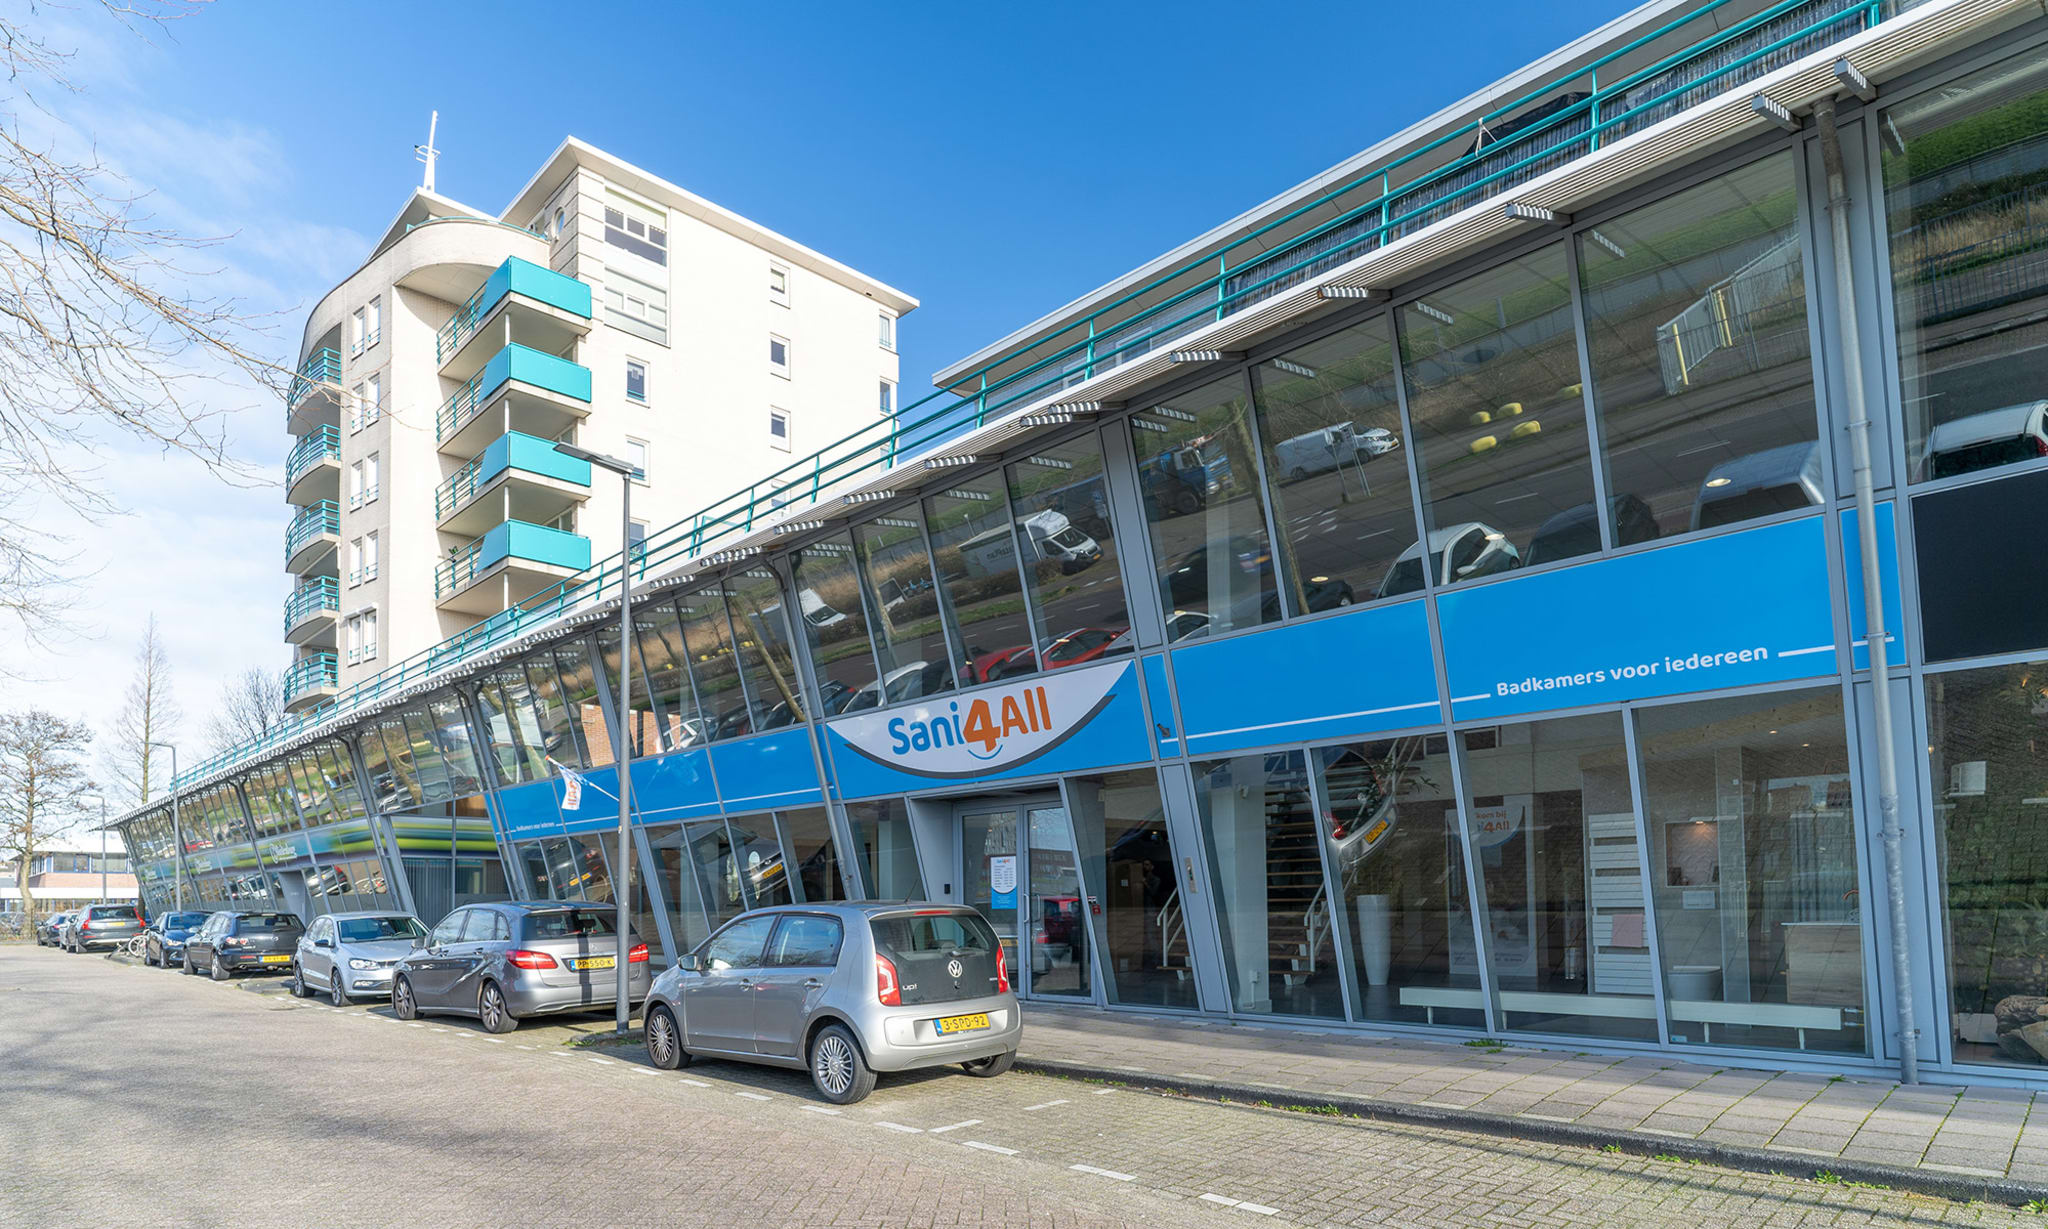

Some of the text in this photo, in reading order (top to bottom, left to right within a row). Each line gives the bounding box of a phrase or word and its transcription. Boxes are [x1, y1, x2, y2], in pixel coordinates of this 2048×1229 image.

[1496, 646, 1769, 697] Badkamers voor iedereen
[887, 686, 1053, 755] Sani4All
[943, 1014, 987, 1031] 3-SPD-92
